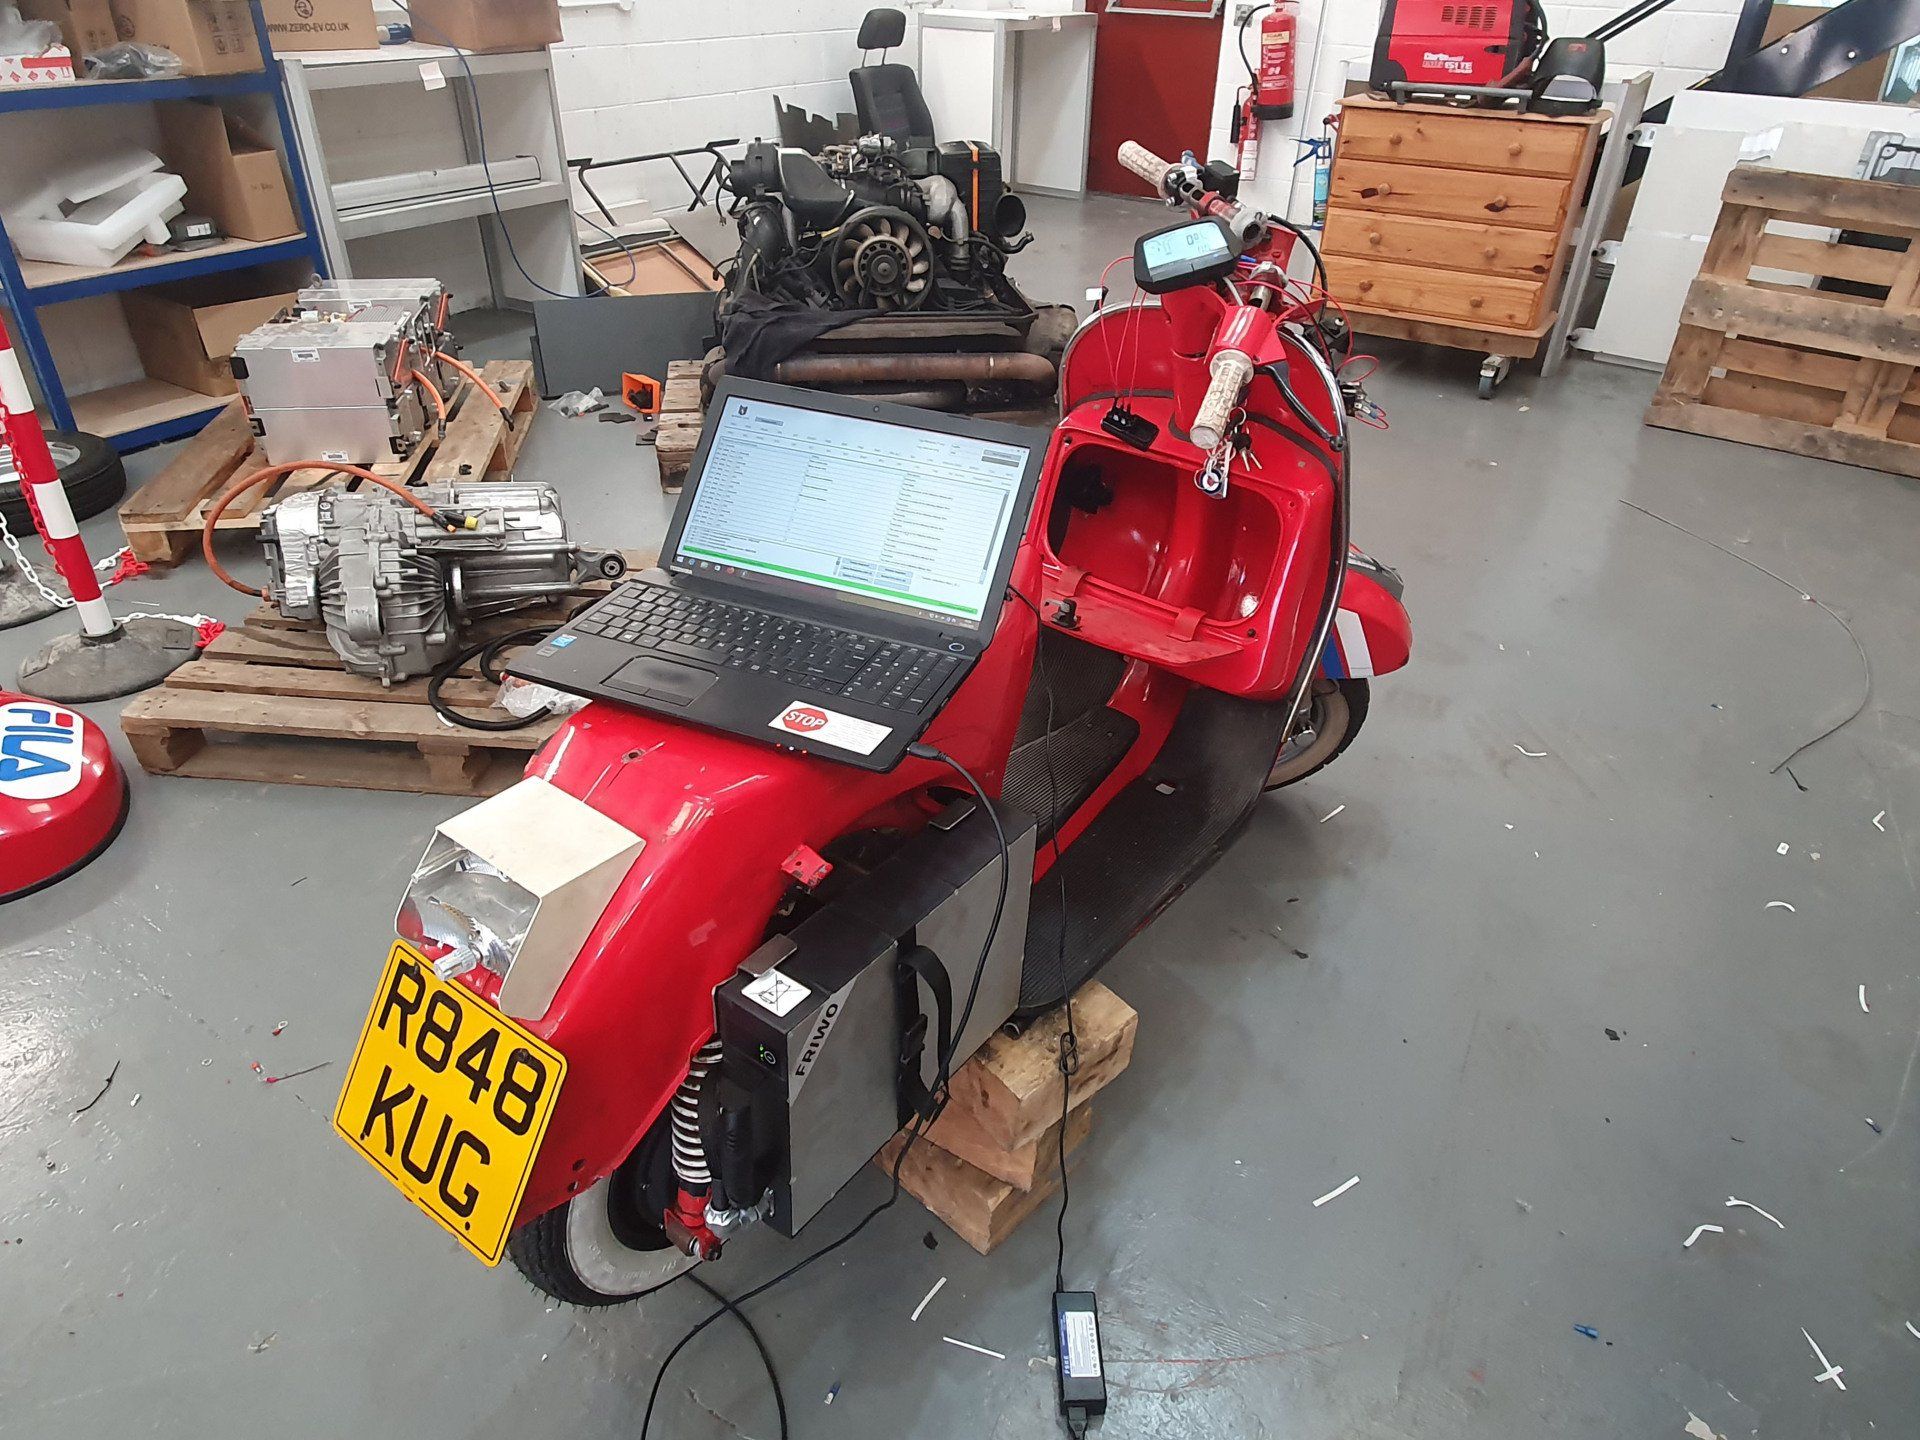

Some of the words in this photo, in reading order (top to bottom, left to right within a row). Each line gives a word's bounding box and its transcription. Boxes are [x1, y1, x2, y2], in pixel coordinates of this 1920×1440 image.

[0, 708, 74, 781] FILA
[785, 711, 826, 728] STOP
[378, 959, 547, 1136] R848
[795, 1003, 839, 1076] FRIWO
[364, 1065, 491, 1218] KUG
